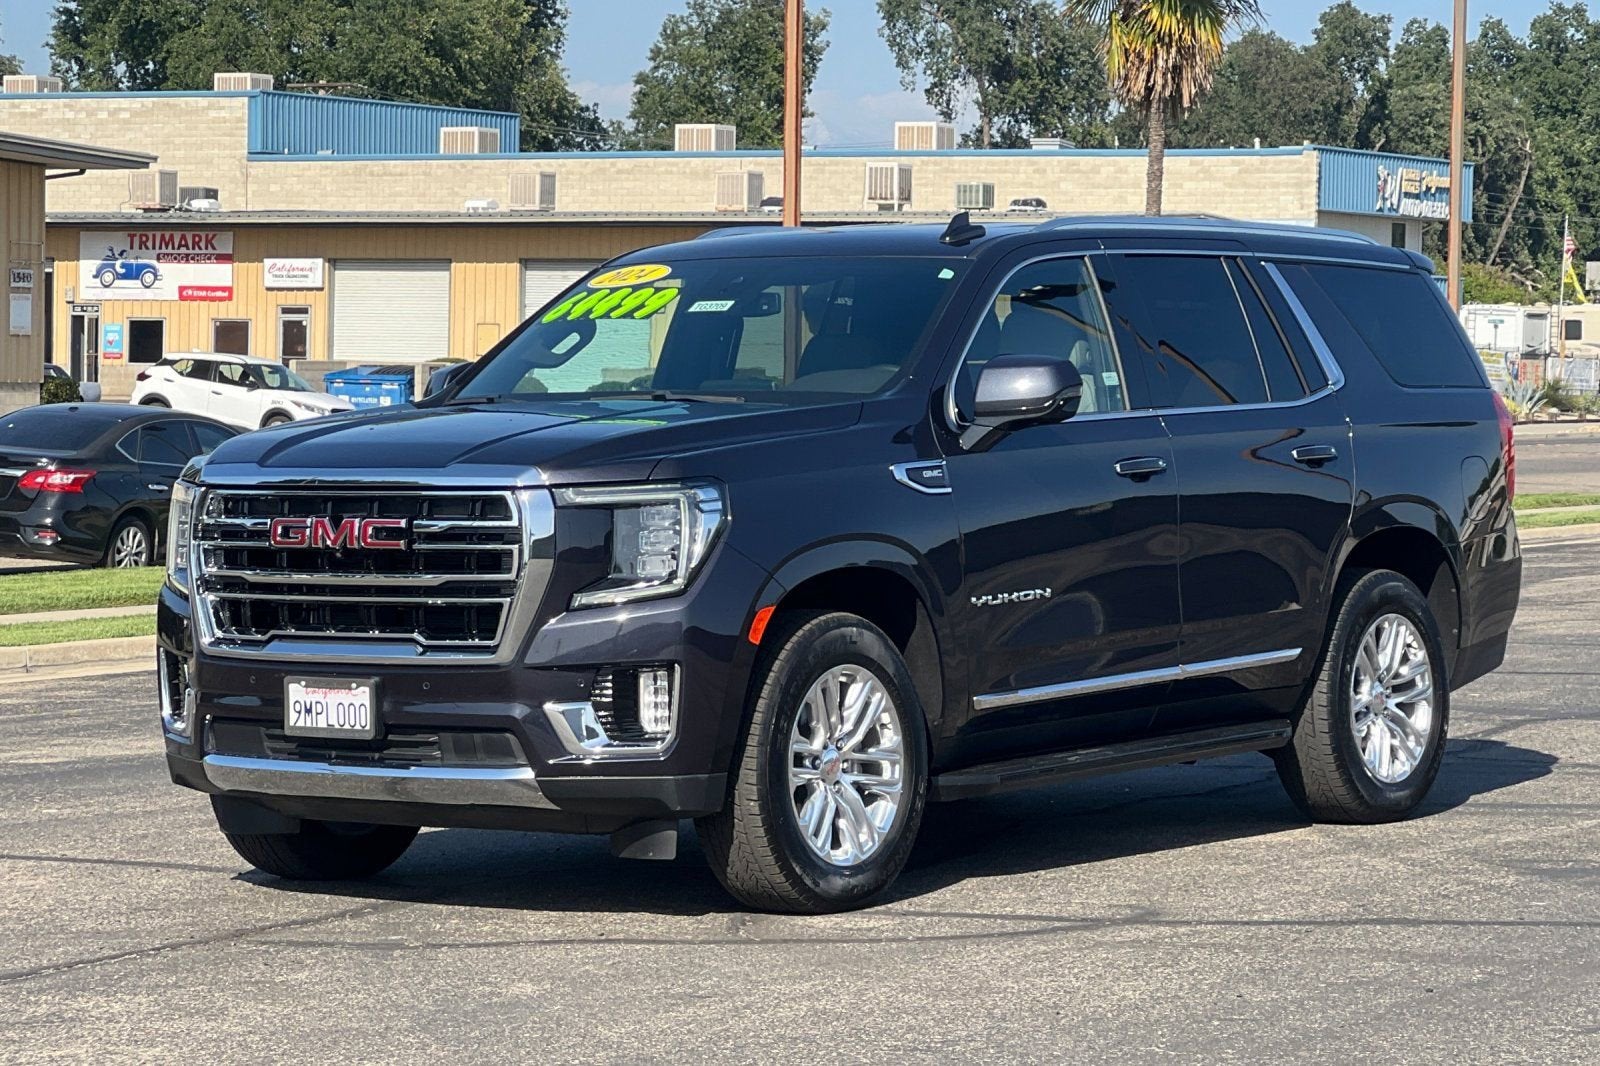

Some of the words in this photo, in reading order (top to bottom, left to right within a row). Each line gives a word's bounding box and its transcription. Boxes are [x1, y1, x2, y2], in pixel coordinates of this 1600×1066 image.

[127, 233, 217, 251] TRIMARK
[159, 254, 187, 263] SMOG
[188, 254, 217, 263] CHECK
[267, 262, 314, 274] California
[594, 266, 663, 285] 2024
[923, 469, 943, 478] GMC
[270, 517, 409, 550] GMC
[970, 587, 1052, 607] YUKON
[293, 699, 368, 729] 9MPL000
